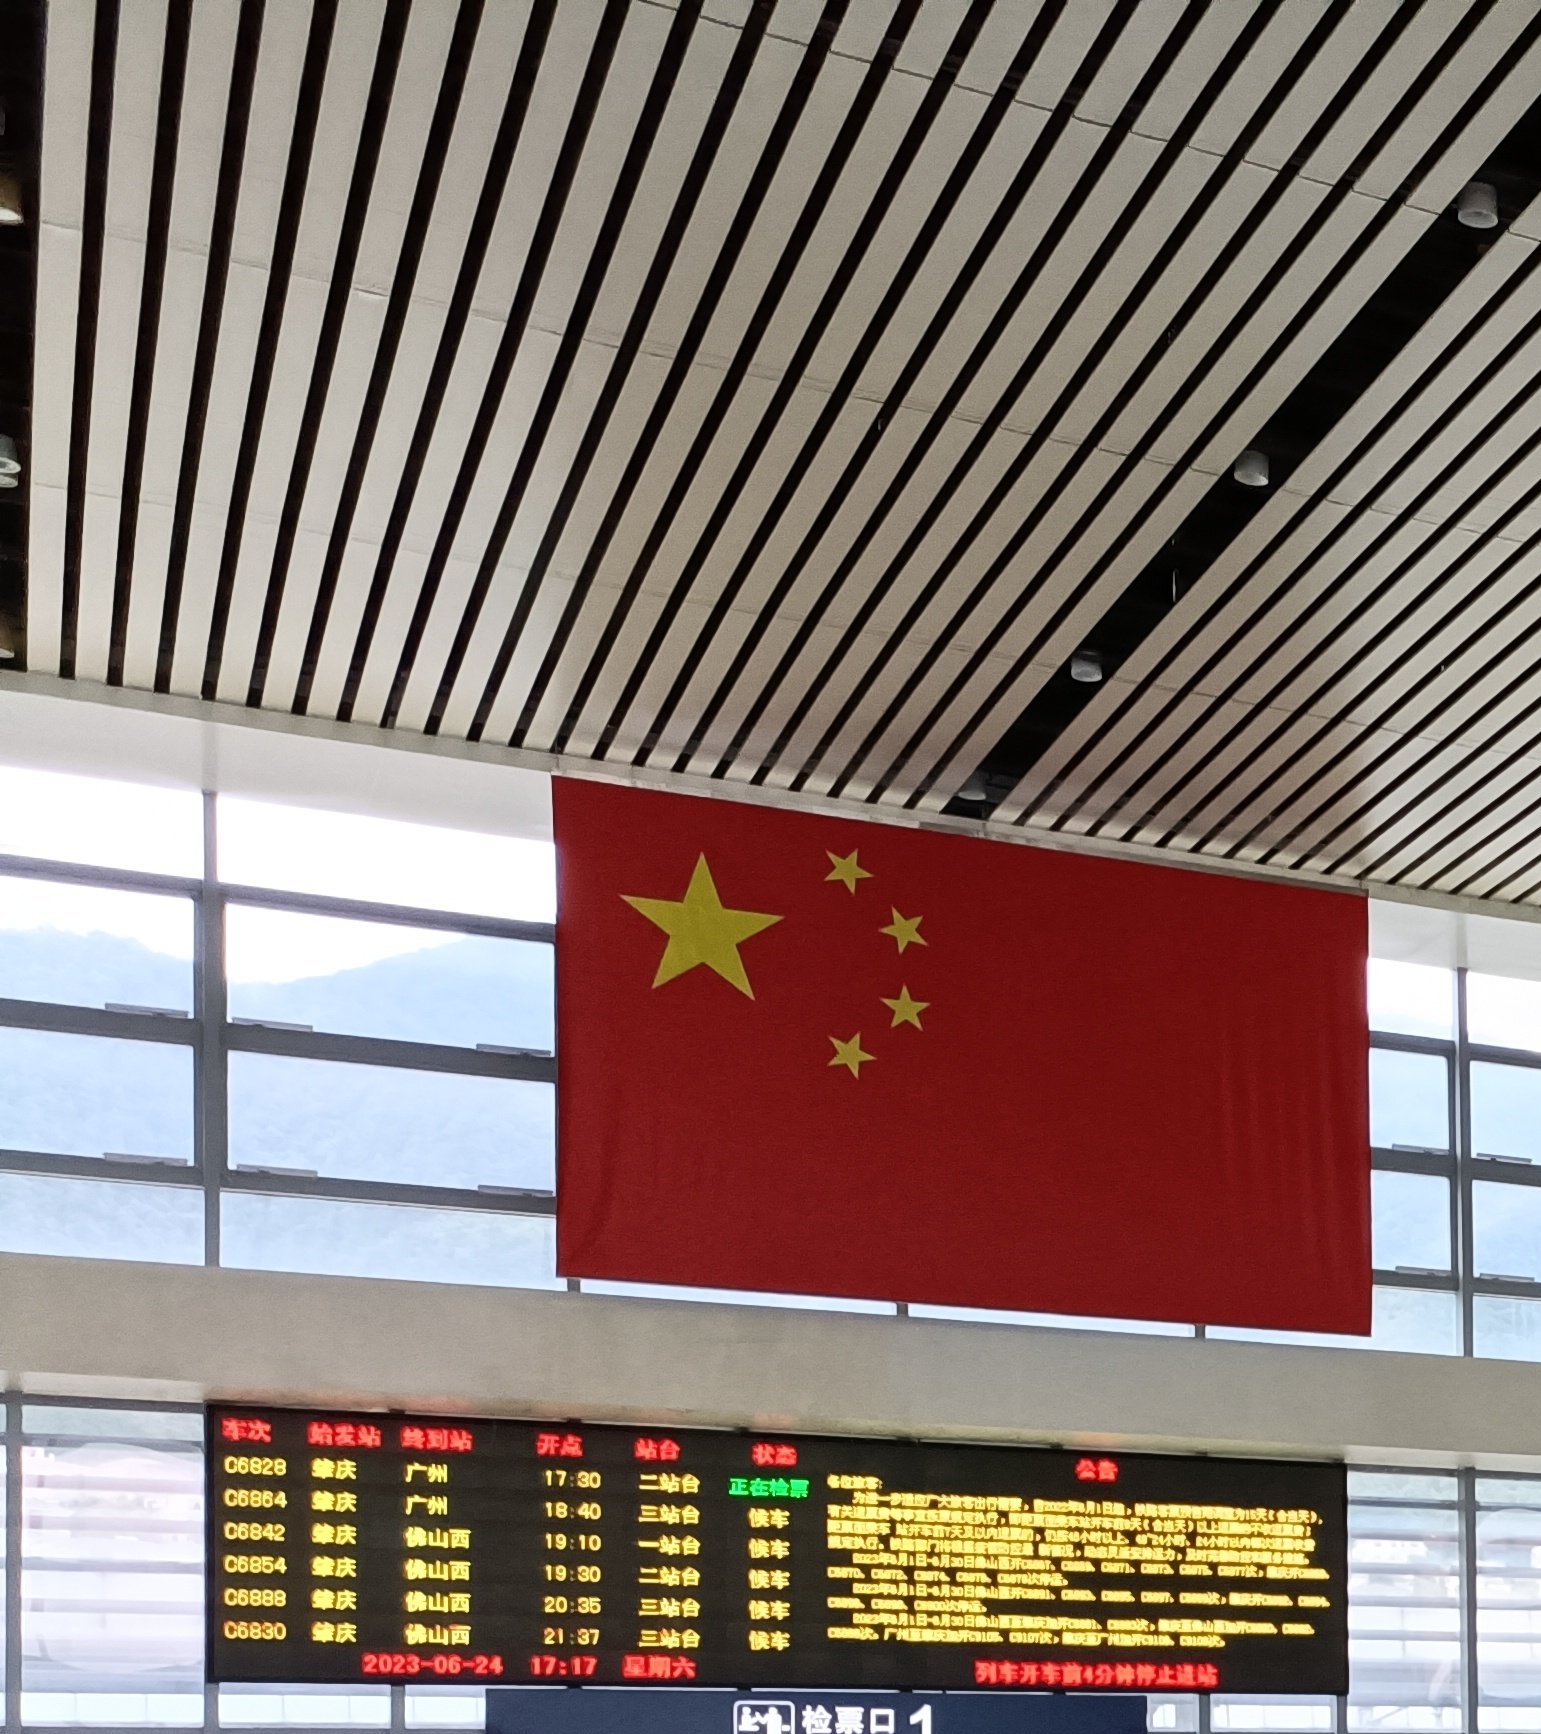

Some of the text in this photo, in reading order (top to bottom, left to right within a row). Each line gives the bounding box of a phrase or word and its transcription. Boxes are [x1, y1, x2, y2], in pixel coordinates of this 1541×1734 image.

[223, 1418, 1118, 1481] 车次 始发站 终到站 开点 站台 状态 公告
[225, 1456, 809, 1498] C6828 肇庆 广州 17:30 二站台 正在检票
[224, 1489, 789, 1528] C6864 肇庆 广州 18:40 三站台 候车
[224, 1522, 790, 1559] C6842 肇庆 佛山西 19:10 一站台 候车
[224, 1555, 790, 1589] C6854 肇庆 佛山西 19:30 二站台 候车
[224, 1589, 790, 1620] C6888 肇庆 佛山西 20:35 三站台 候车
[224, 1621, 790, 1650] C6830 肇庆 佛山西 21:37 三站台 候车
[363, 1654, 695, 1678] 2023-06-24 17:17 星期六
[975, 1660, 1219, 1688] 列车开车前4分钟停止进站
